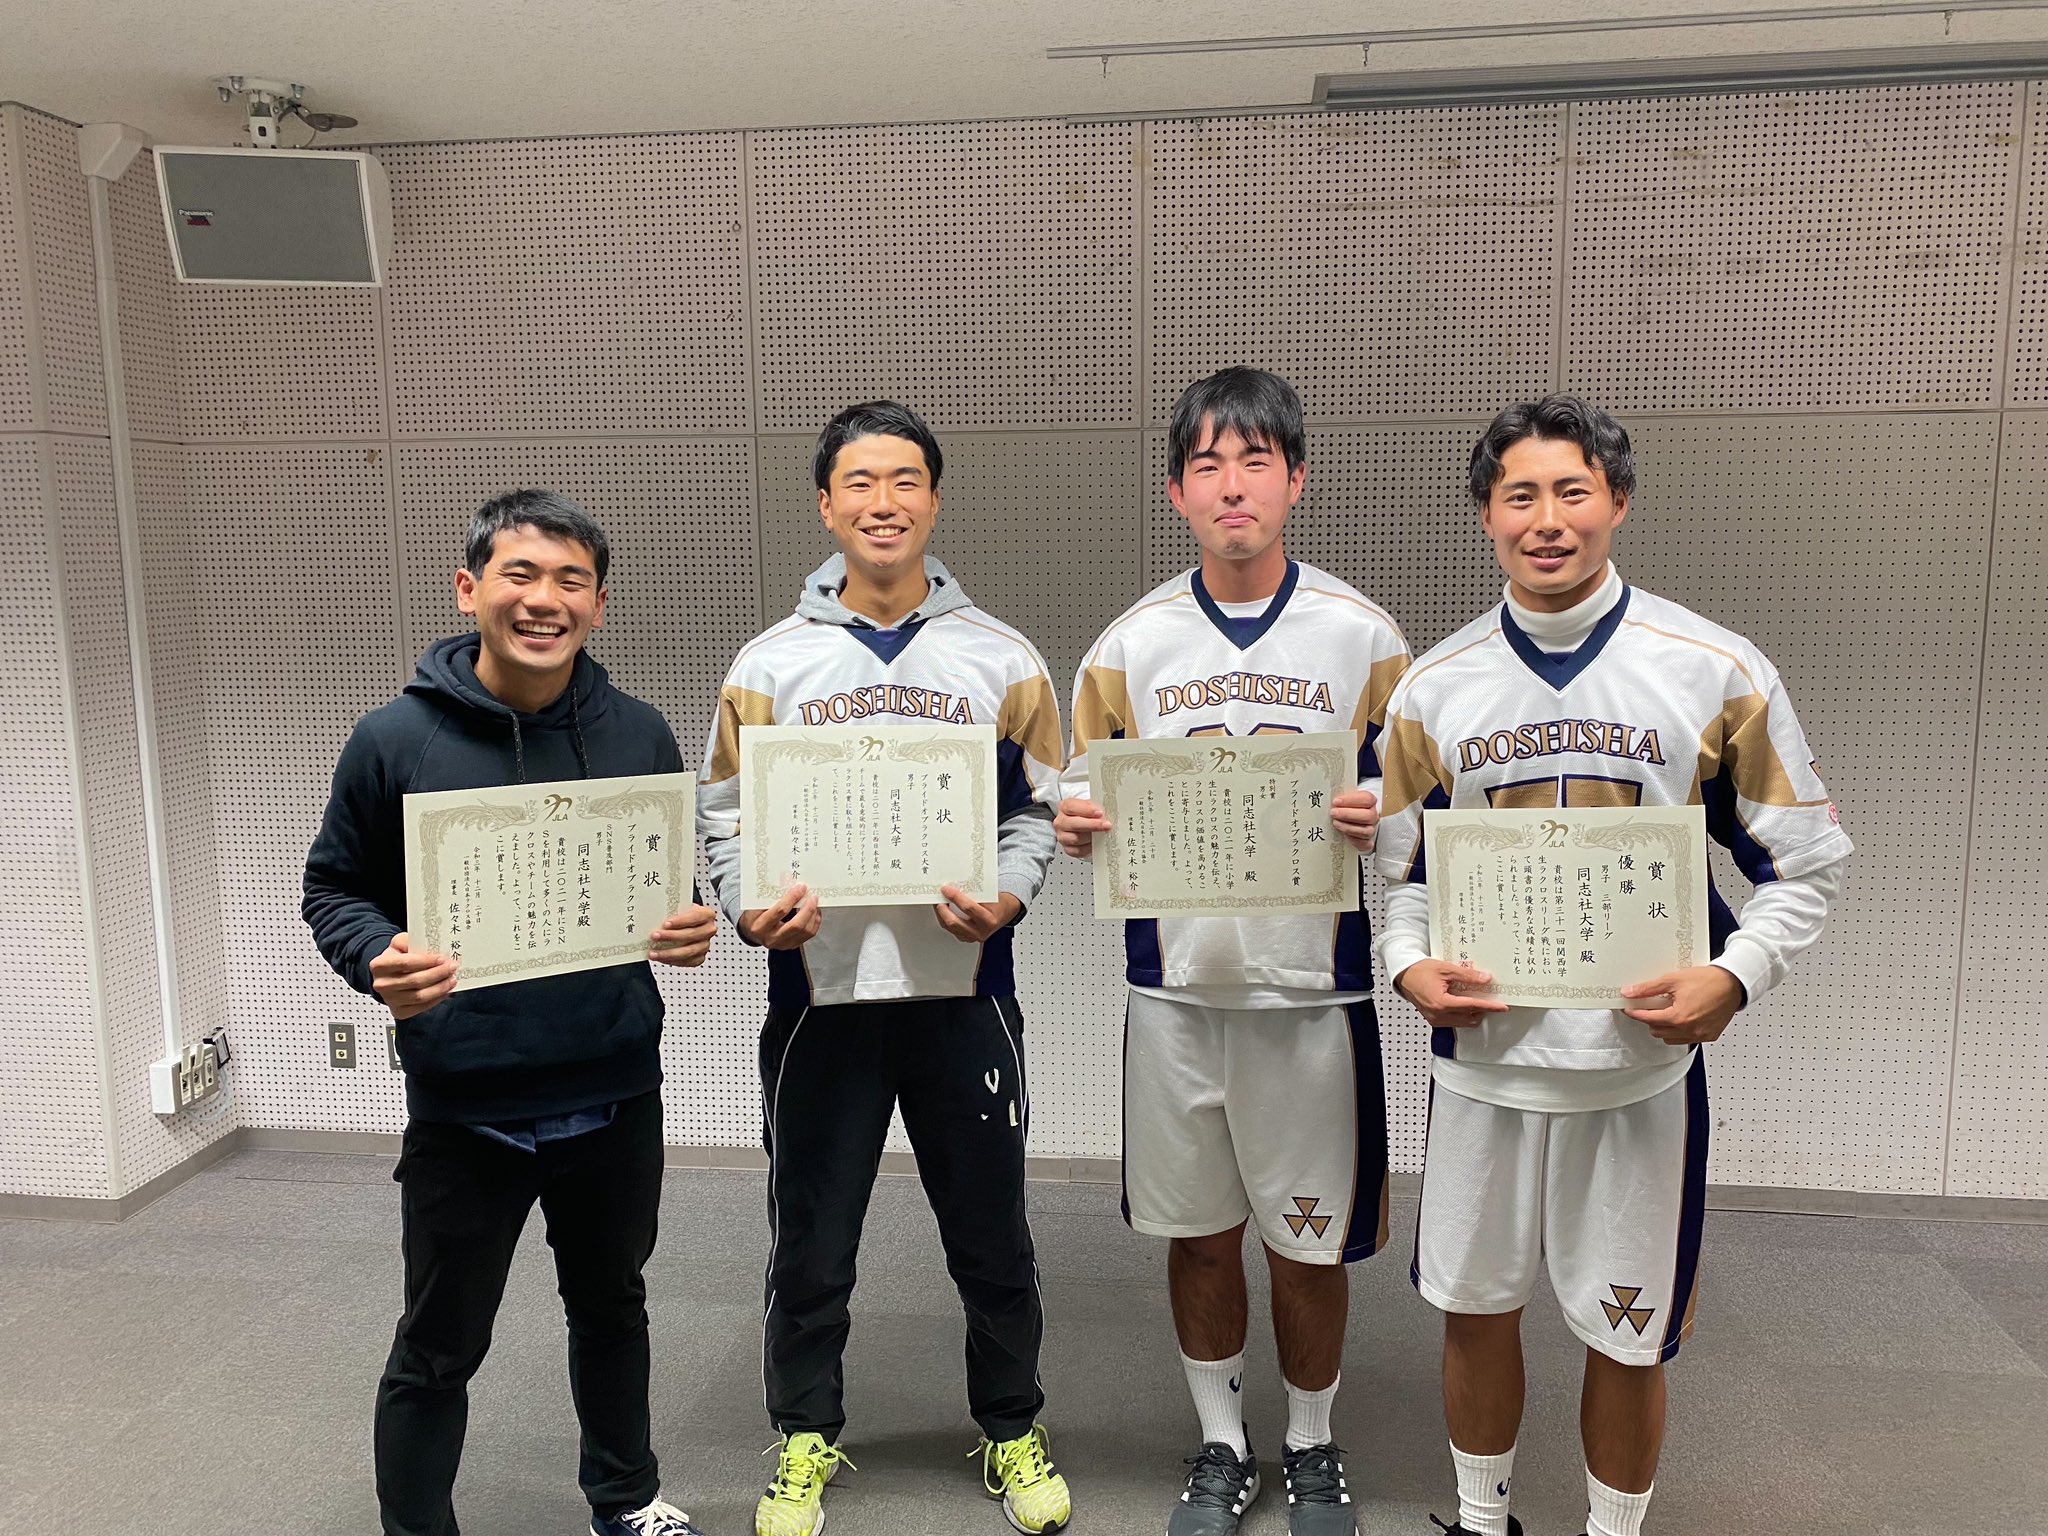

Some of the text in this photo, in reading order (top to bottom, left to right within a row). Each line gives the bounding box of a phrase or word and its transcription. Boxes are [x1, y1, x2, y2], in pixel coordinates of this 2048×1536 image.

[799, 684, 977, 726] DOSHISHA
[1155, 671, 1335, 717] DOSHISHA
[1457, 719, 1666, 773] DOSHISHA
[552, 813, 569, 821] JLA
[1290, 779, 1301, 886] プライドオブラクロス賞
[577, 843, 591, 927] 同志社大学殿
[626, 823, 637, 934] プライドオブラクロス賞
[1617, 854, 1636, 895] 優勝
